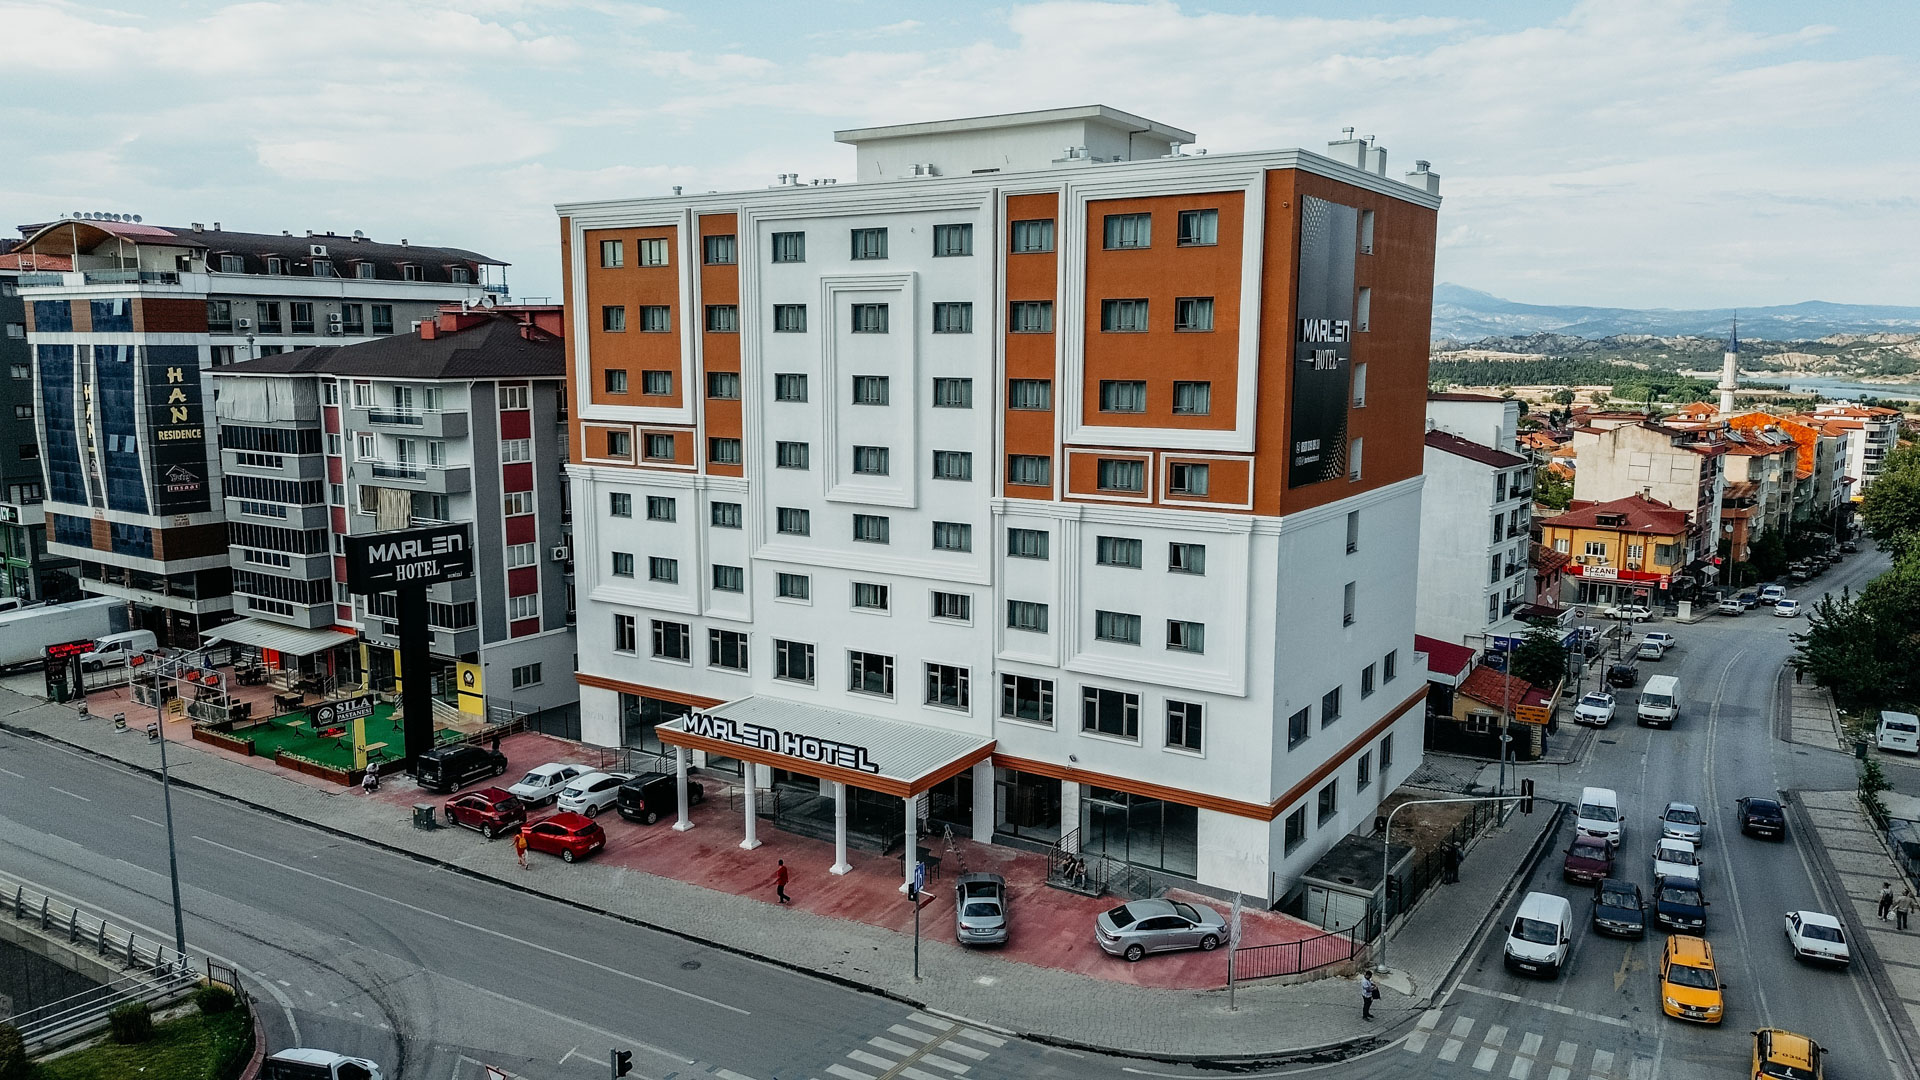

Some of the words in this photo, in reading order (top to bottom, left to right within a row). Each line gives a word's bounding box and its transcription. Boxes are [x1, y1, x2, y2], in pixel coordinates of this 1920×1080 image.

[1303, 318, 1350, 343] MARLEN
[1315, 349, 1338, 371] HOTEL
[167, 366, 188, 424] HAN
[158, 429, 202, 441] RESIDENCE
[368, 534, 463, 564] MARLEN
[395, 560, 441, 581] HOTEL
[1584, 566, 1616, 575] ECZANE
[682, 712, 778, 752] MARLEN
[783, 732, 879, 773] HOTEL
